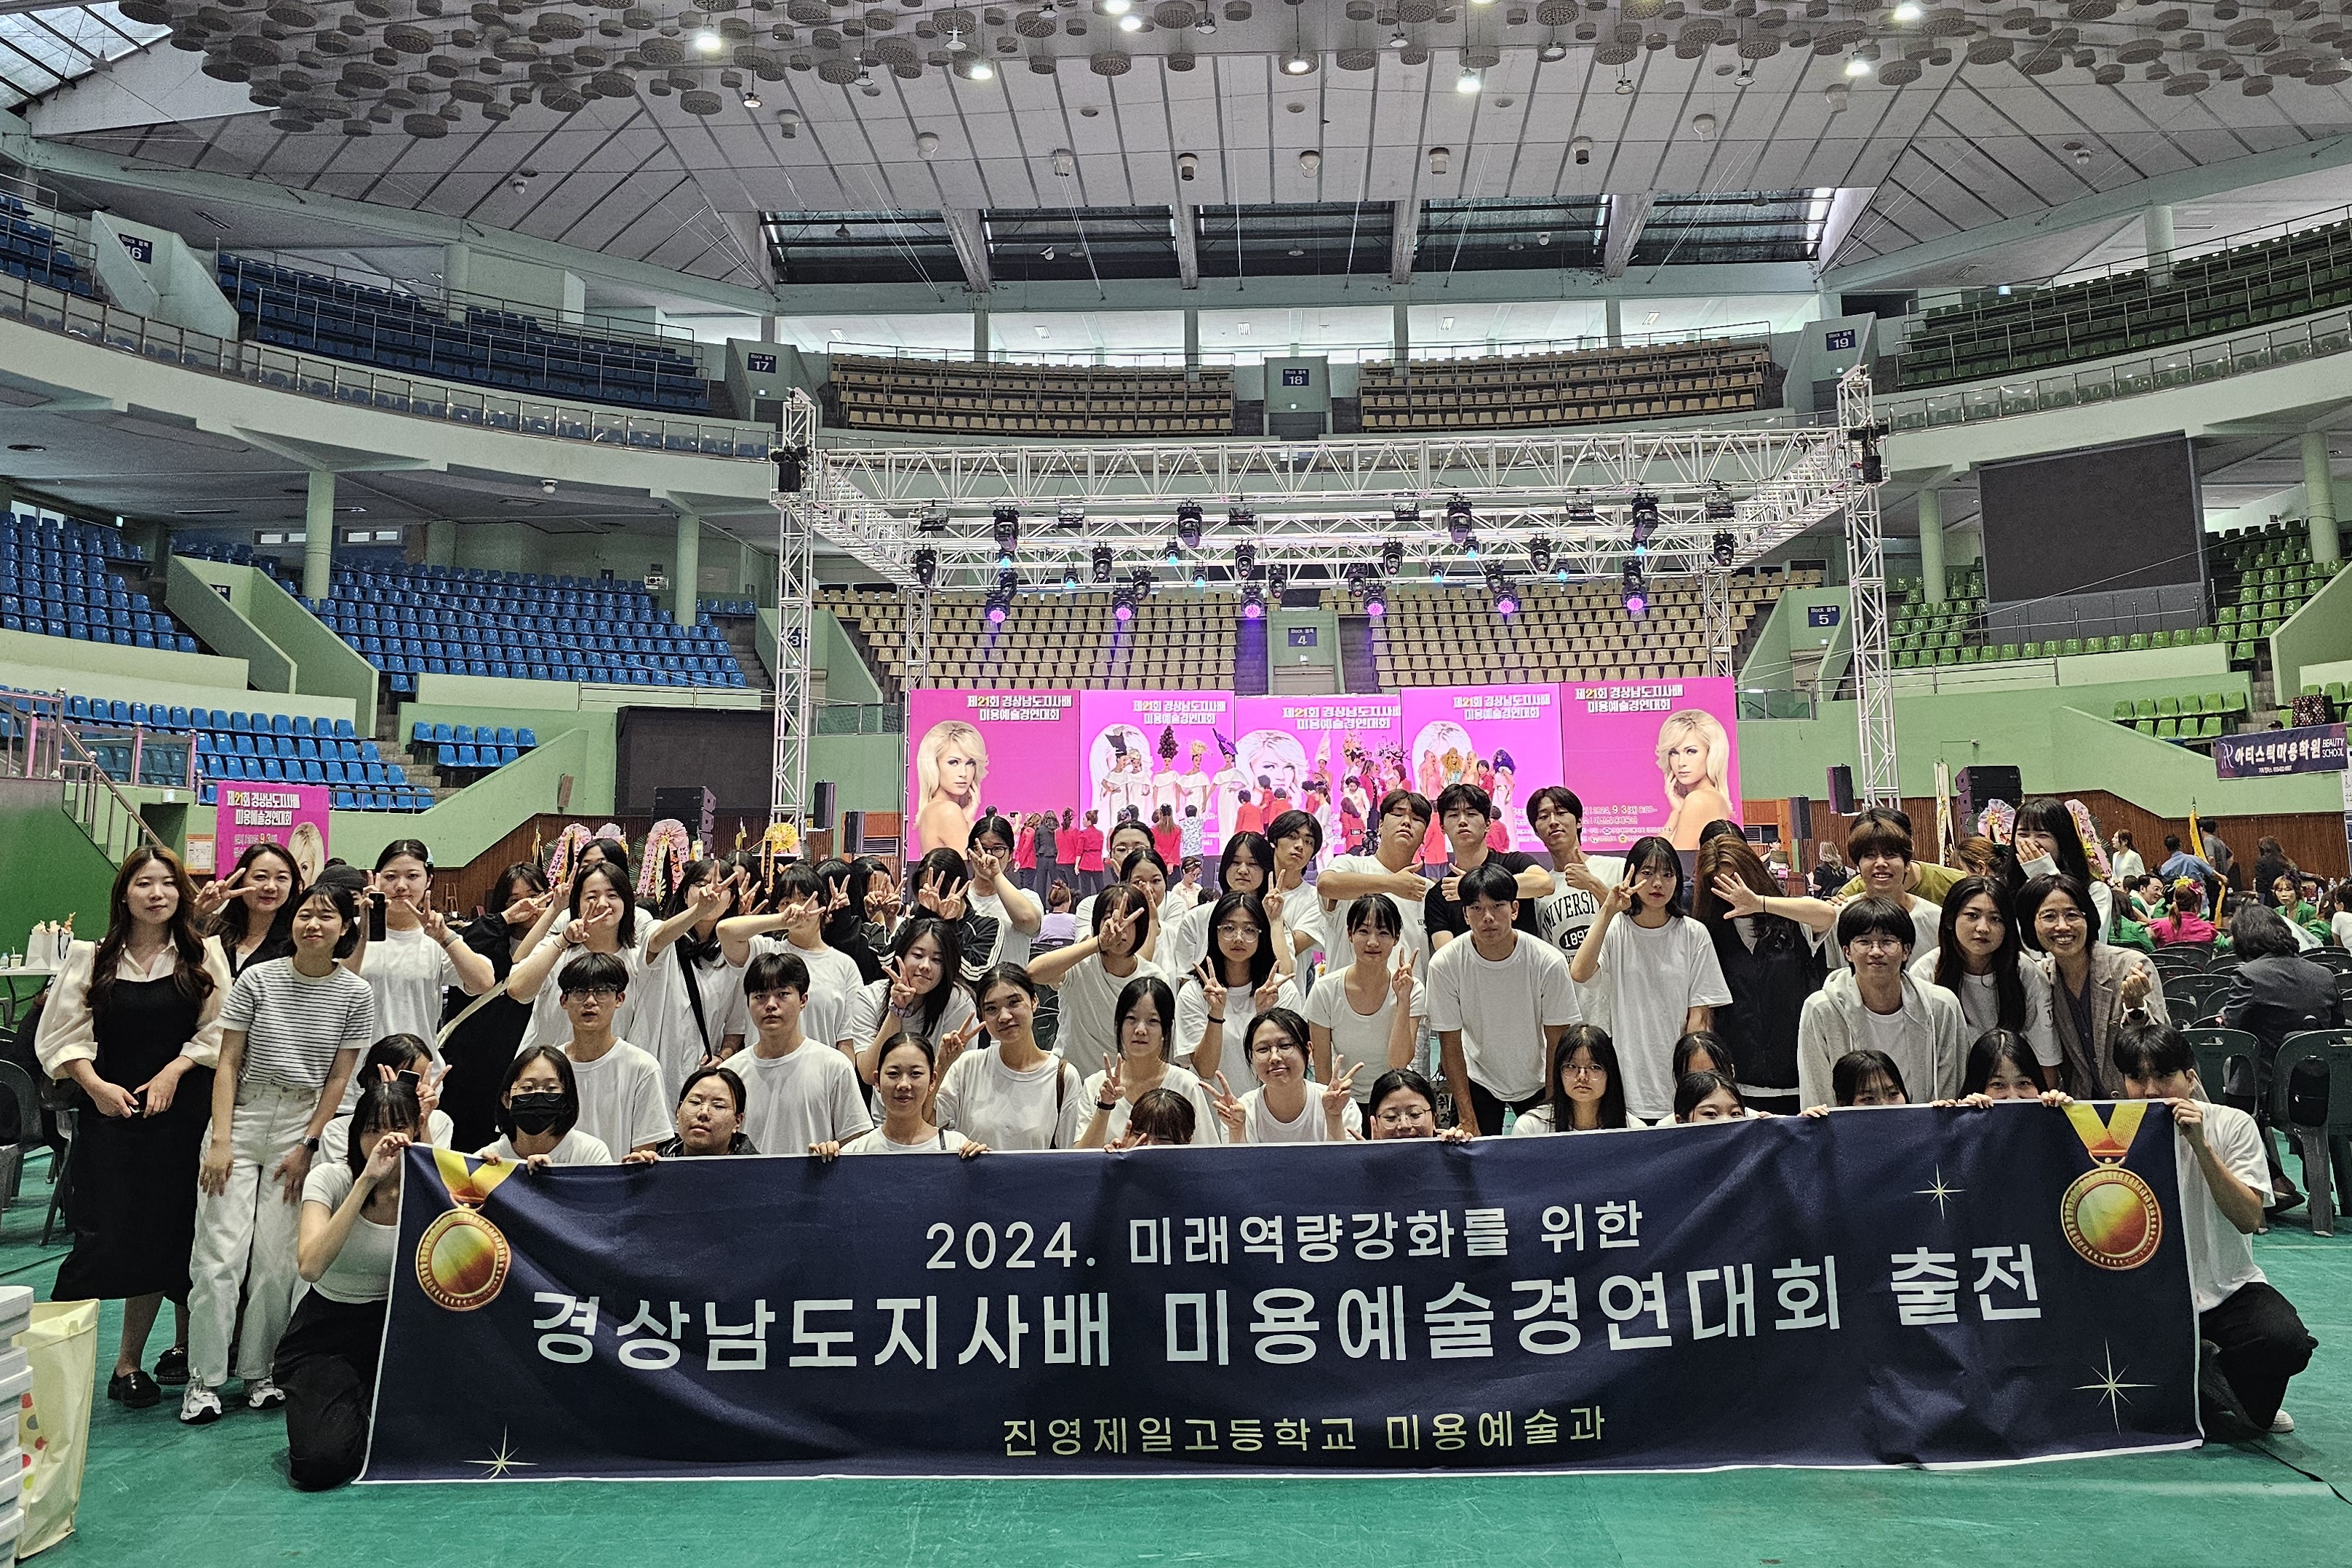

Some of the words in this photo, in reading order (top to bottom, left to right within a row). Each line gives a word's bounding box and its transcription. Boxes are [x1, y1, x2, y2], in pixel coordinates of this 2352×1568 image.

[1833, 337, 1849, 348] 19
[754, 361, 769, 371] 17
[1289, 375, 1303, 385] 18
[1819, 614, 1829, 625] 5
[1297, 635, 1308, 645] 4
[1575, 687, 1608, 700] 제21회
[1609, 684, 1684, 699] 경상남도지사배
[967, 695, 1000, 708] 제21회
[1001, 695, 1072, 708] 경상남도지사배
[1587, 698, 1671, 713] 미용예술경연대회
[979, 708, 1060, 721] 미용예술경연대회
[2322, 737, 2345, 748] BEAUTY
[2234, 737, 2321, 766] 아티스틱미용학원
[2322, 748, 2345, 758] SCHOOL
[226, 791, 249, 807] 제21회
[251, 792, 300, 809] 경상남도지사배
[235, 809, 292, 825] 미용예술경연대회
[1543, 891, 1596, 943] UNIVERSI
[925, 1220, 1096, 1271] 2024.
[1129, 1207, 1510, 1266] 미래역량강화를
[1540, 1199, 1644, 1254] 위한
[532, 1292, 1110, 1372] 경상남도지사배
[1164, 1255, 1841, 1367] 미용예술경연대회
[1889, 1243, 2042, 1327] 출전
[1003, 1417, 1358, 1457] 진영제일고등학교
[1385, 1405, 1606, 1452] 미용예술과
